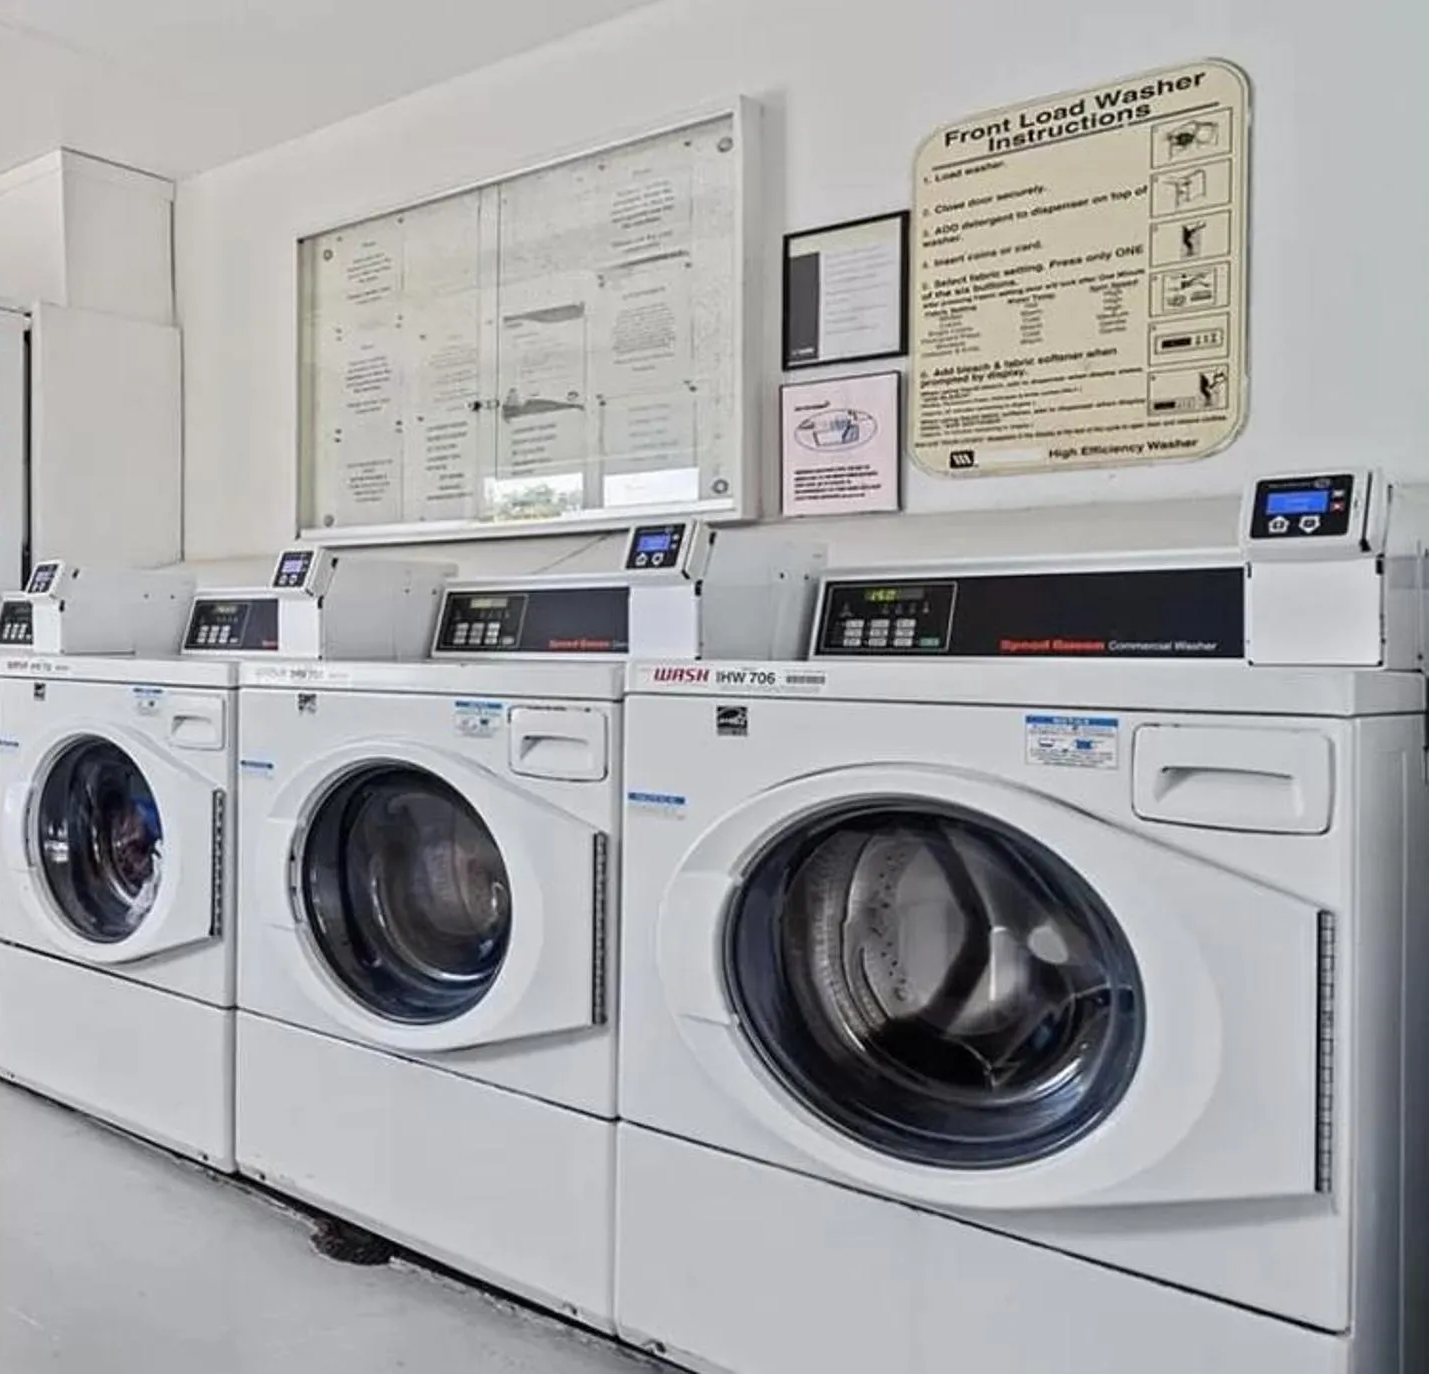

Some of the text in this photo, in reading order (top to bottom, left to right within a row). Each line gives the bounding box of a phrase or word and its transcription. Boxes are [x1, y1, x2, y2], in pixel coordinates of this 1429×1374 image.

[944, 72, 1207, 148] Front Load Washer
[988, 104, 1152, 152] Instructions
[934, 169, 963, 183] Load
[934, 202, 966, 215] Close
[967, 195, 993, 208] door
[996, 184, 1047, 201] securely.
[934, 223, 960, 236] ADD
[961, 212, 1014, 231] detergent
[1016, 210, 1029, 219] to
[1030, 198, 1090, 217] dispenser
[1091, 194, 1109, 205] on
[1110, 188, 1133, 201] top
[1133, 184, 1148, 197] of
[933, 254, 965, 268] Insert
[967, 248, 998, 263] coins
[999, 246, 1012, 256] or
[1014, 239, 1043, 253] card.
[933, 275, 967, 290] Select
[968, 270, 1001, 282] fabric
[1049, 256, 1084, 270] Press
[1085, 251, 1113, 263] only
[1115, 243, 1145, 258] ONE
[921, 291, 933, 301] of
[934, 290, 952, 299] the
[934, 366, 955, 377] Add
[956, 362, 991, 375] bleach
[993, 360, 1002, 370] &
[1003, 357, 1035, 368] fabric
[1036, 352, 1084, 365] softener
[1085, 346, 1118, 359] when
[919, 368, 1028, 390] prompted by display.
[1049, 438, 1199, 460] High Efficiency Washer
[1107, 639, 1173, 650] Commercial
[1174, 639, 1219, 650] Washer
[654, 667, 710, 682] WASH
[749, 671, 777, 685] 706
